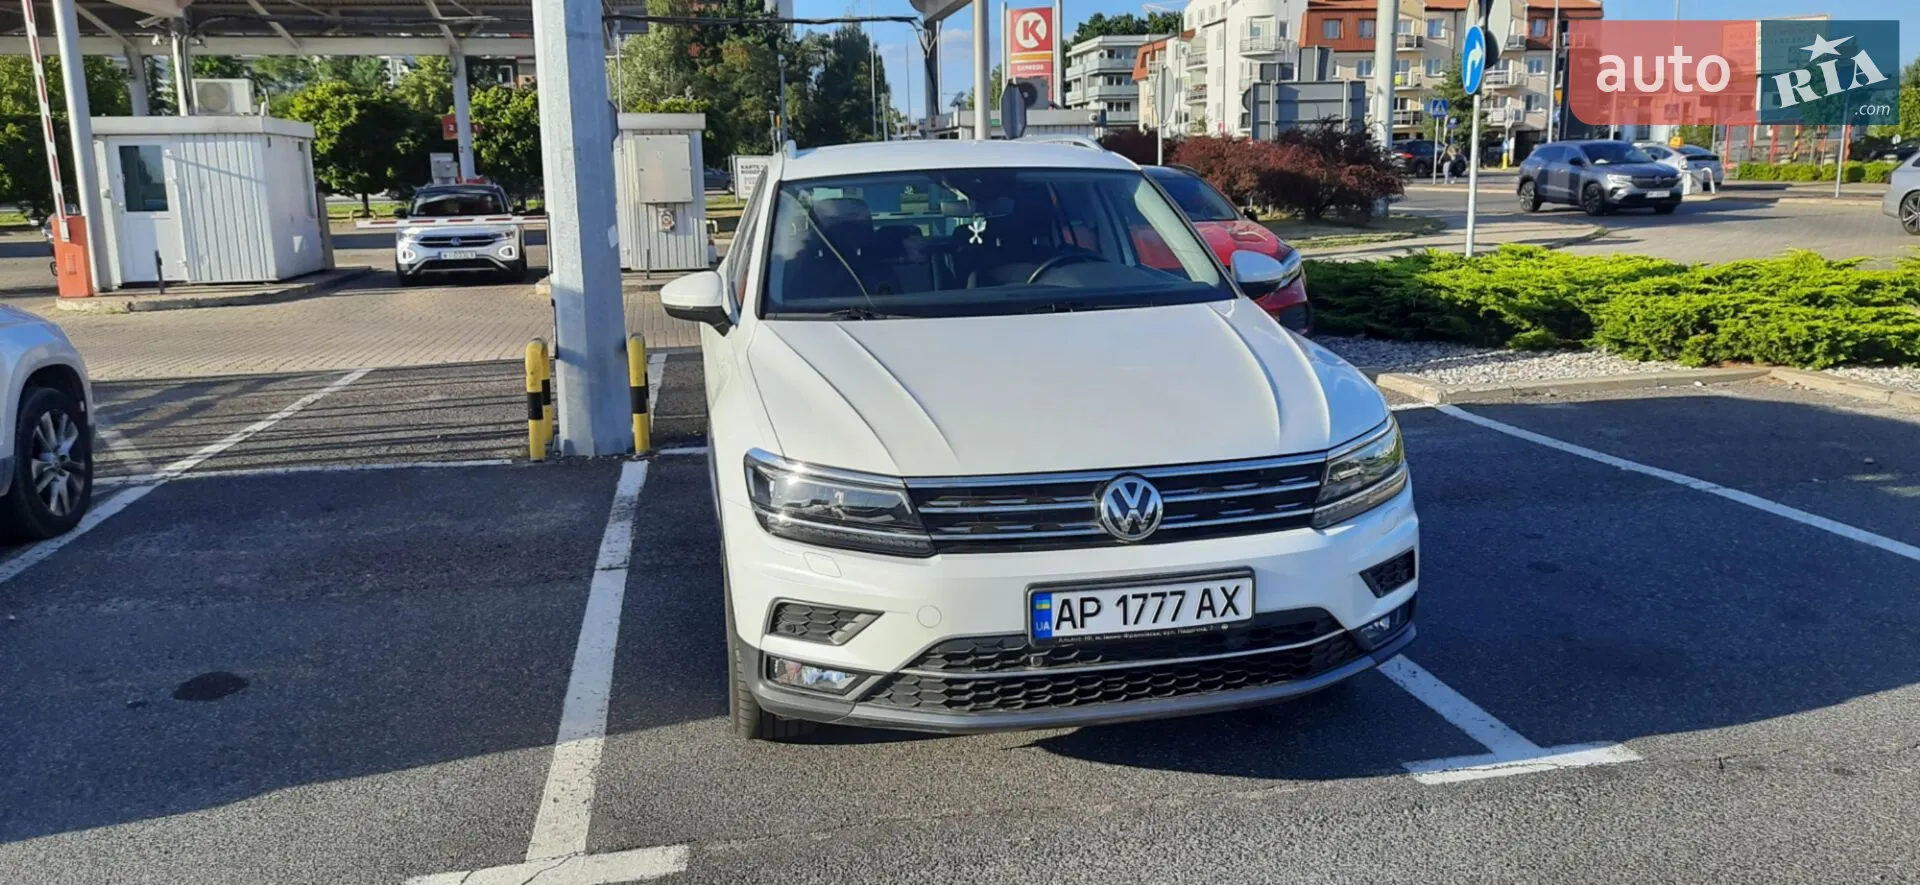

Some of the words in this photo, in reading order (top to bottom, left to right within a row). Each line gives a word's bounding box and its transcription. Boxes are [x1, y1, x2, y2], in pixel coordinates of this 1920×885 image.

[1055, 596, 1101, 631] AP
[1115, 590, 1186, 626] 1777
[1196, 585, 1240, 620] AX
[1036, 621, 1051, 632] UA
